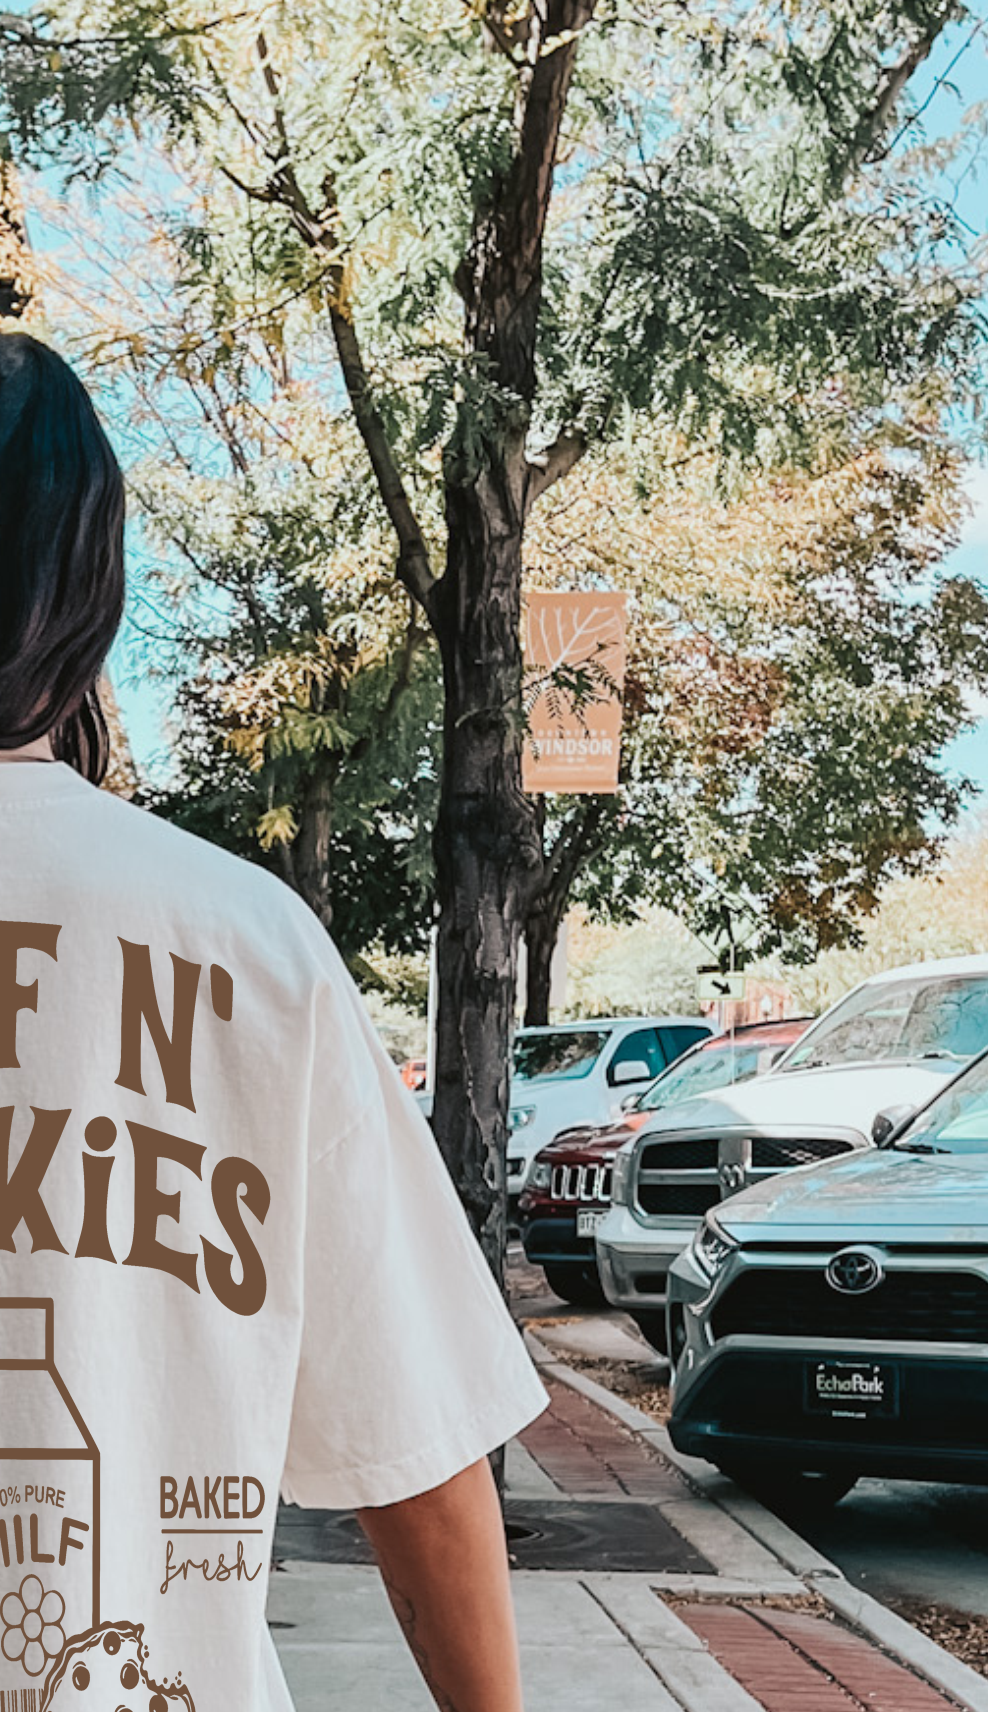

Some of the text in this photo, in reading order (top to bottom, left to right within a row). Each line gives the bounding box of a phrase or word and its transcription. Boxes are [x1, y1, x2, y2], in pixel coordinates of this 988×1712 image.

[114, 936, 234, 1114] N'
[816, 1373, 884, 1394] EchoPark
[25, 1484, 67, 1509] PURE
[160, 1475, 266, 1520] BAKED
[159, 1540, 263, 1595] fresh
